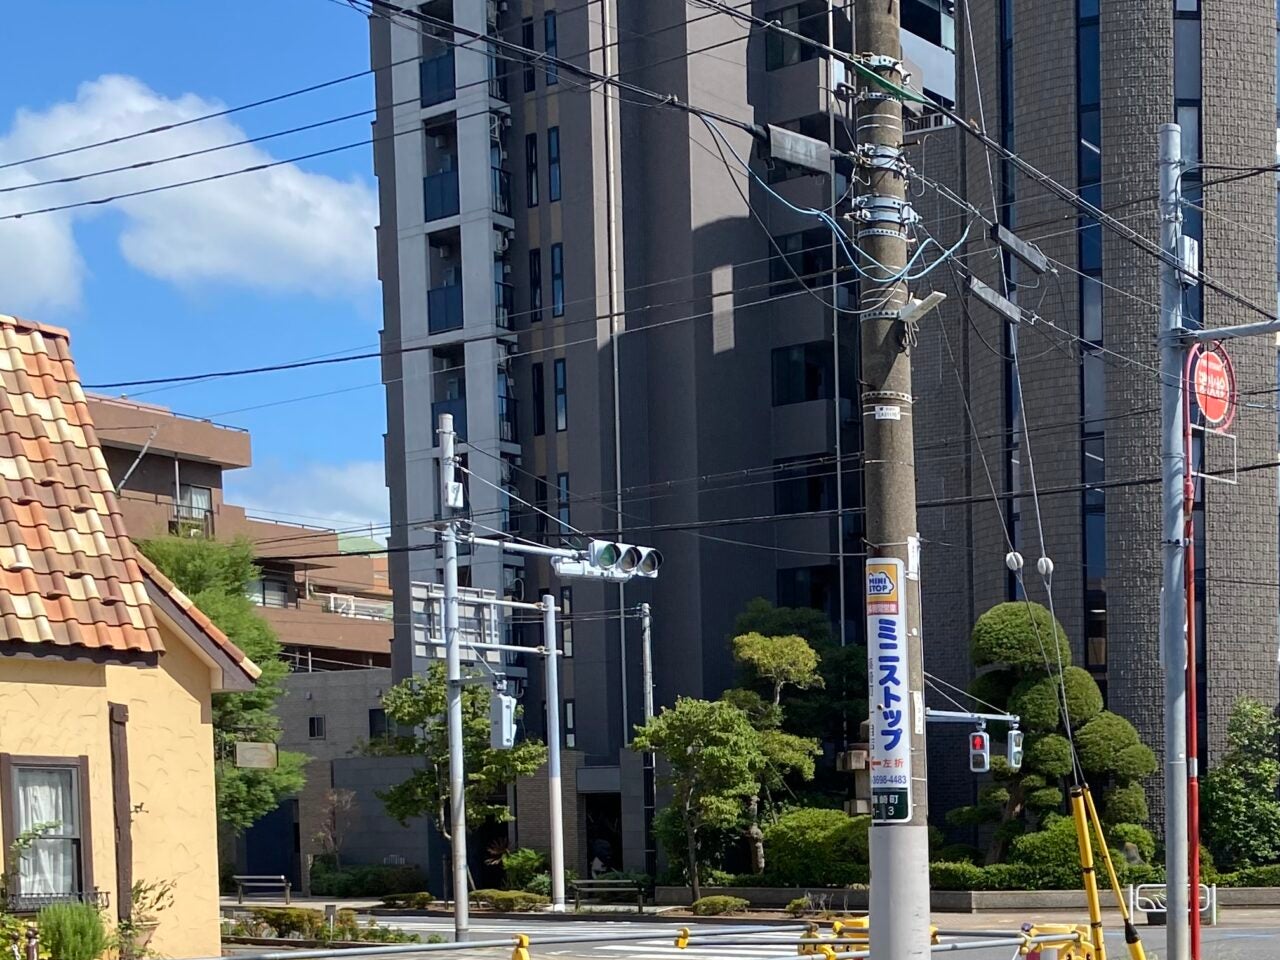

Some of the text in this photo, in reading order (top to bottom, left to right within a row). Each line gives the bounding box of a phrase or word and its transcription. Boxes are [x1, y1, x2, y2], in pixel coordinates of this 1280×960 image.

[869, 577, 886, 585] MINI
[877, 618, 903, 752] ミニストップ
[882, 758, 904, 769] 左折
